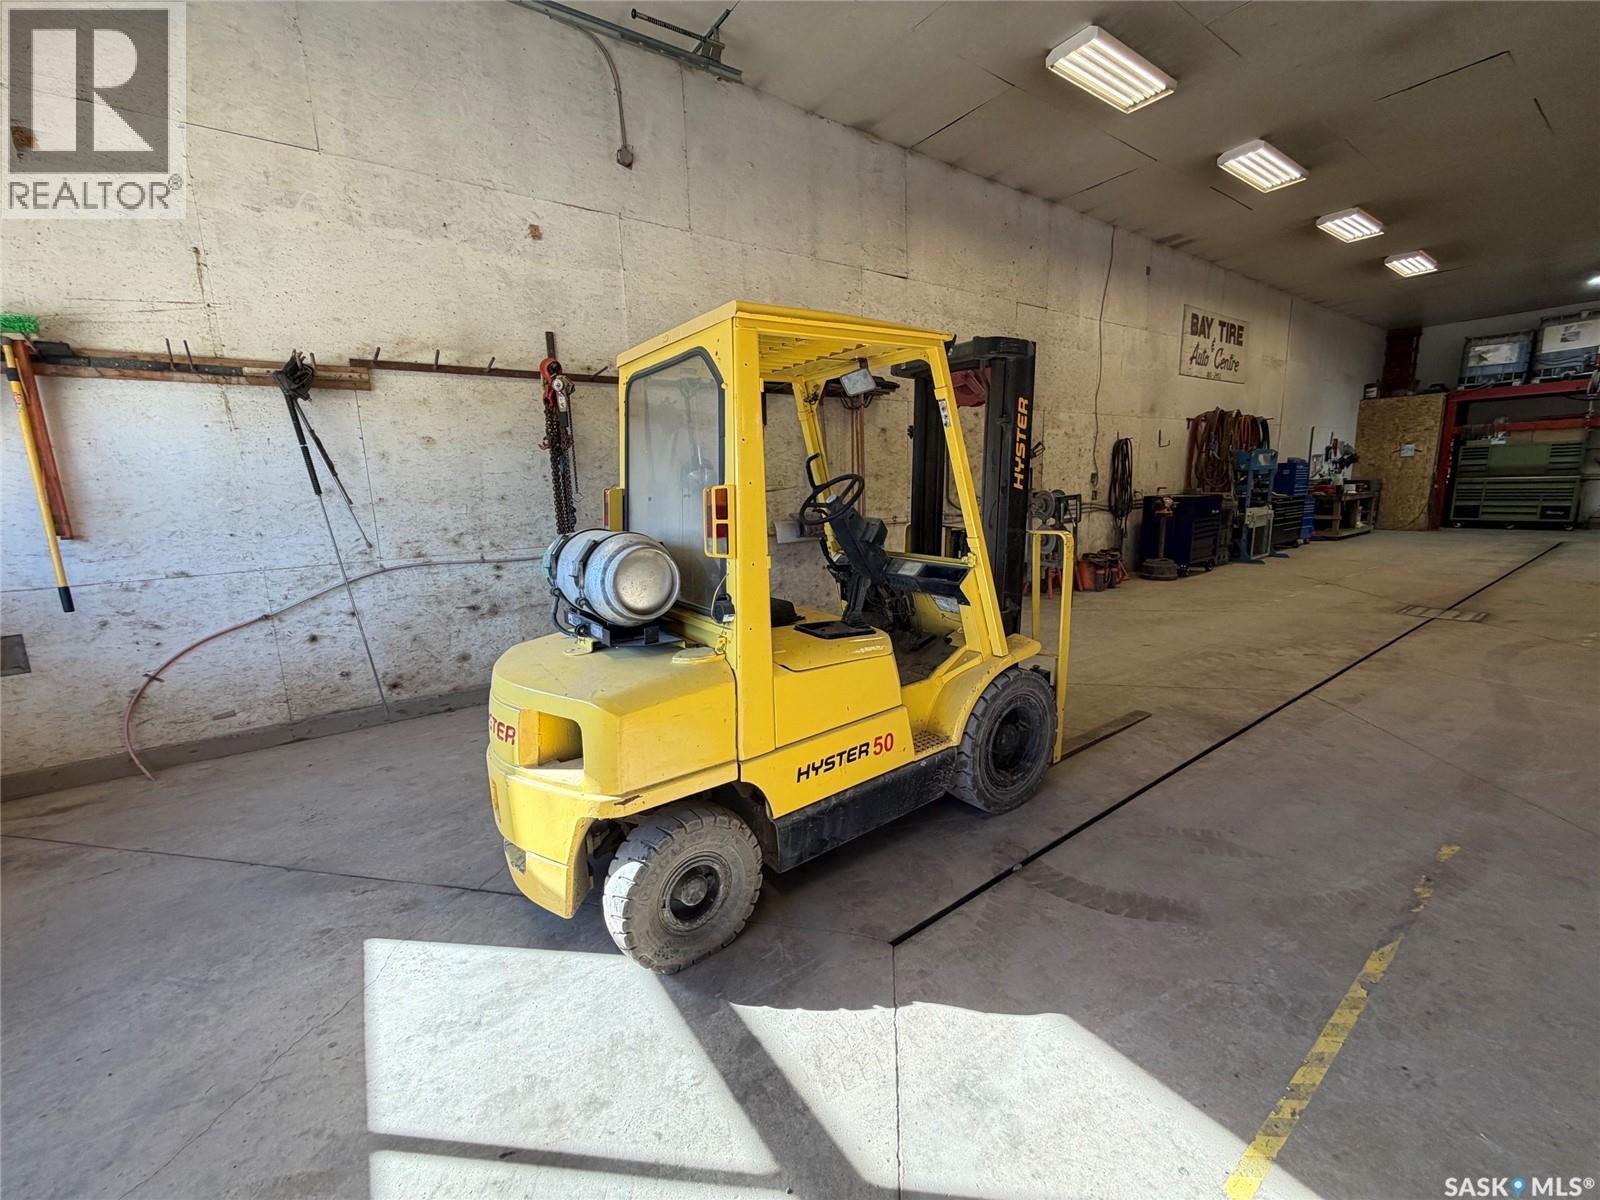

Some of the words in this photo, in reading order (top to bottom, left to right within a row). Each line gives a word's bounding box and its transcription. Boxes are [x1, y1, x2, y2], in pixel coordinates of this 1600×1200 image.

[1190, 312, 1215, 340] BAY
[1218, 320, 1244, 347] TIRE
[1190, 341, 1209, 367] Auto
[1213, 347, 1240, 372] Centre
[1013, 396, 1029, 491] HYSTER
[489, 713, 516, 746] TER
[796, 741, 870, 784] HYSTER
[873, 732, 894, 756] 50
